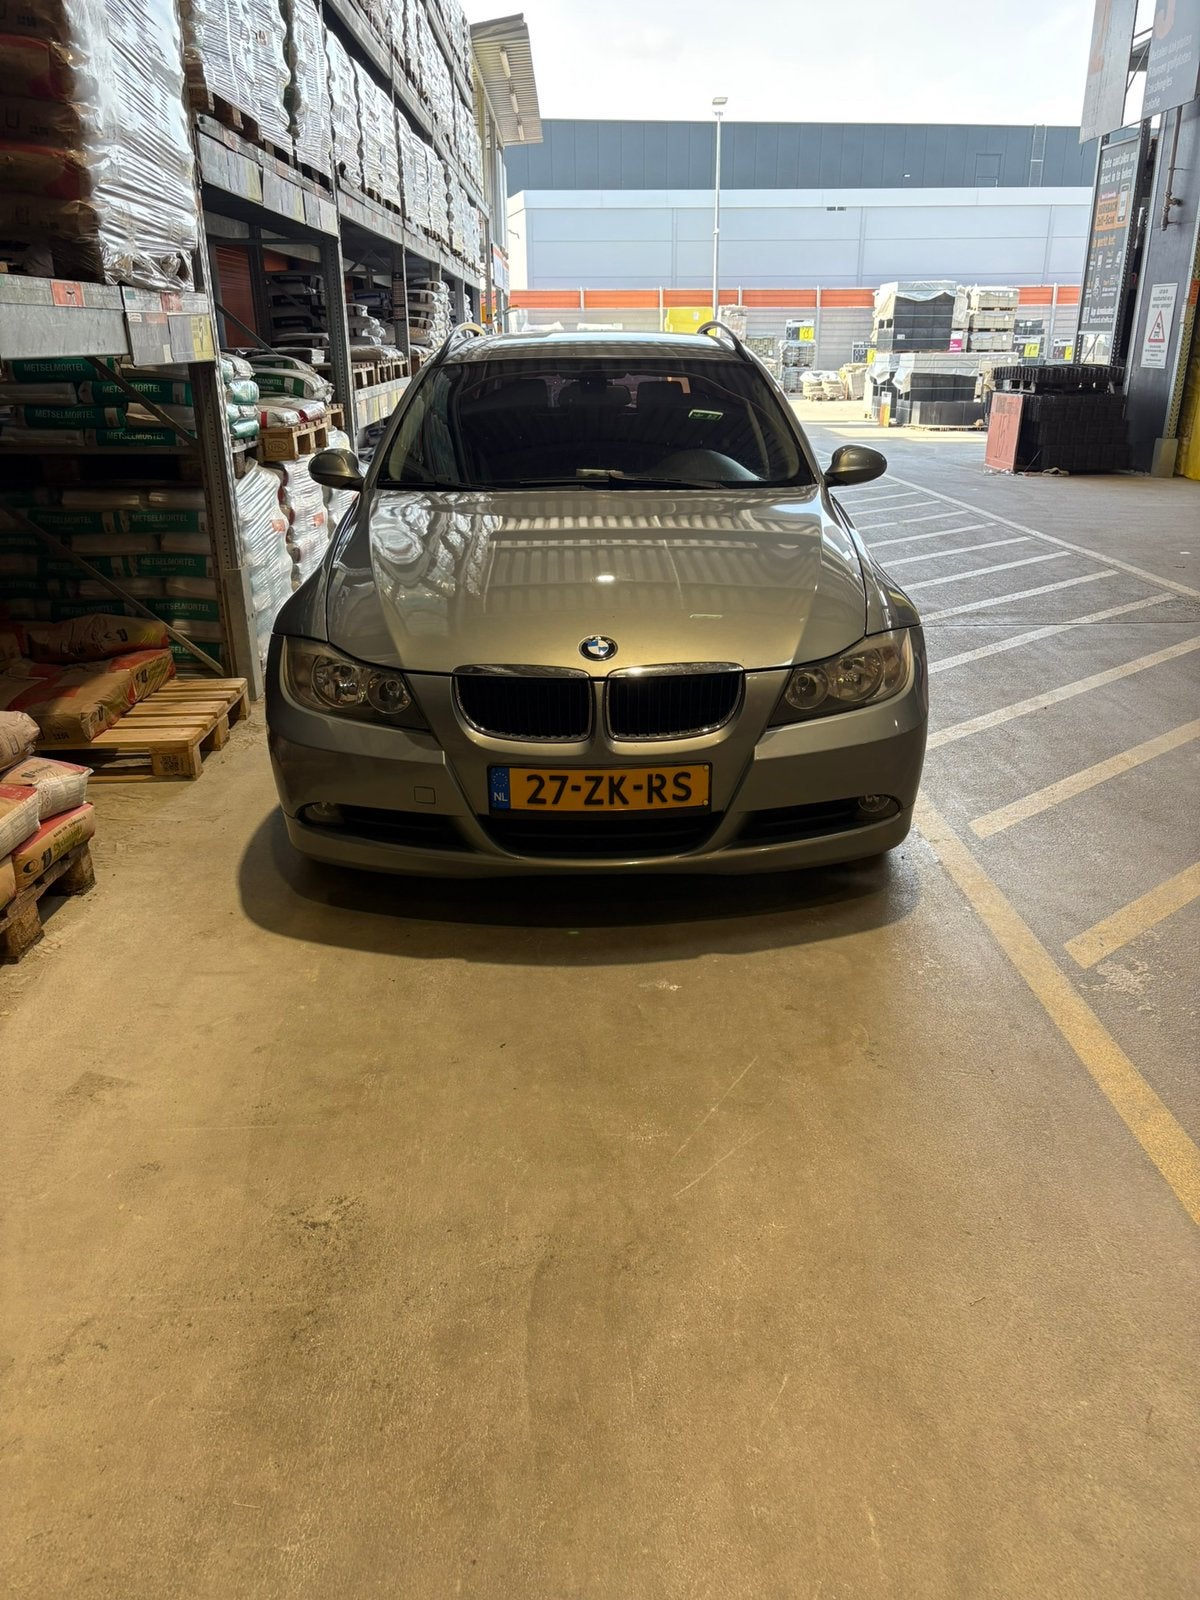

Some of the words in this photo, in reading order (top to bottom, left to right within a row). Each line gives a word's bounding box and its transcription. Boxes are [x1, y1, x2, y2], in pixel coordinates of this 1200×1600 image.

[23, 363, 86, 372] METSELMORTEL
[102, 383, 162, 393] METSMORTEL
[35, 410, 95, 419] METSELMORTEL
[106, 432, 165, 440] METSELMORTEL
[132, 514, 188, 522] METSELMORTEL
[140, 558, 197, 567] METSELMORTEL
[526, 771, 692, 806] 27-ZK-RS
[493, 792, 508, 802] NL
